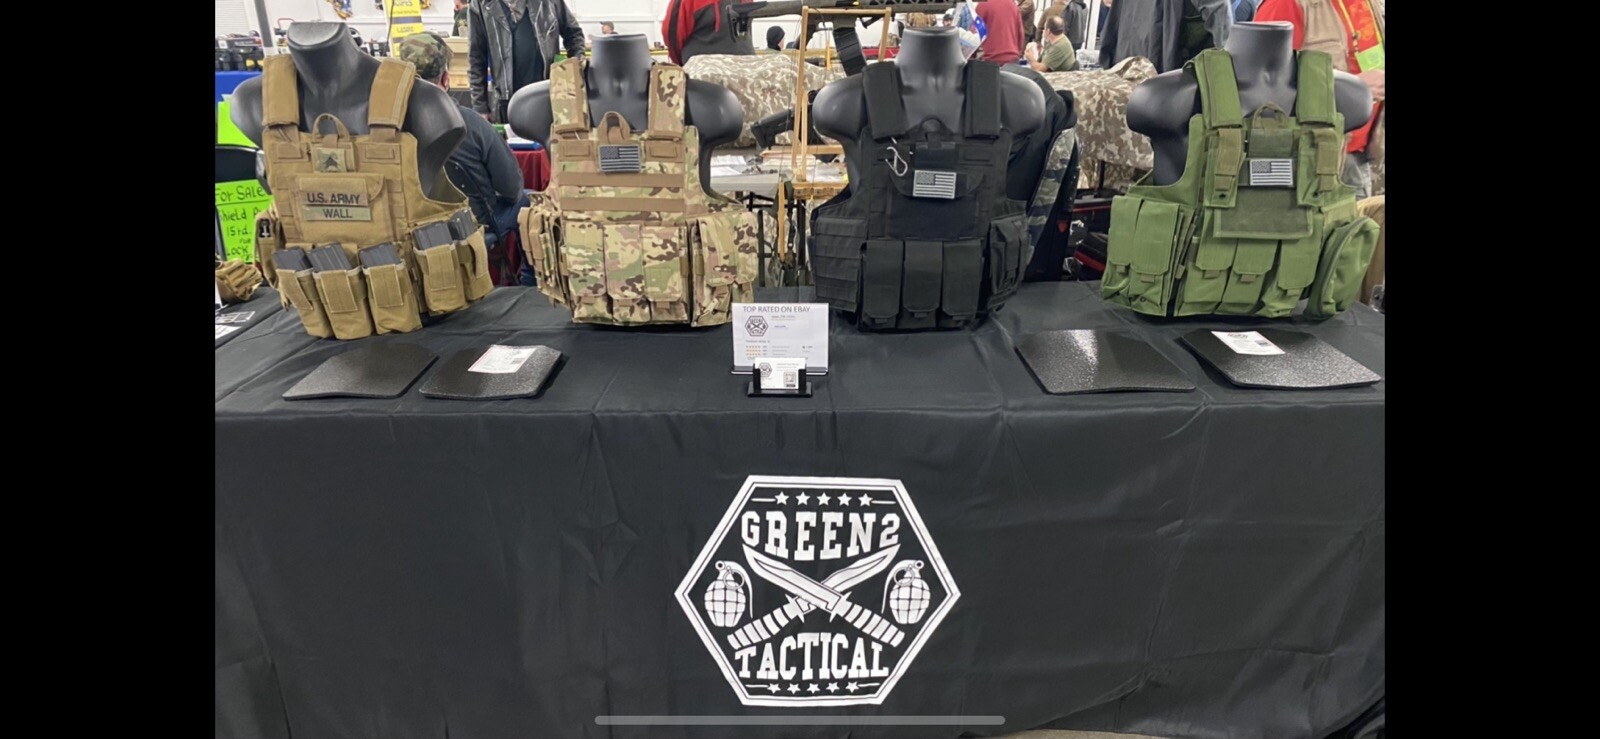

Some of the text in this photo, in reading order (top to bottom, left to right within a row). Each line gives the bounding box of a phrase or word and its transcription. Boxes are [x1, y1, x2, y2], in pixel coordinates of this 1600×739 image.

[306, 192, 360, 204] U.S. ARMY
[322, 208, 353, 219] WALL
[741, 510, 901, 561] GREEN2
[734, 631, 890, 681] TACTICAL
